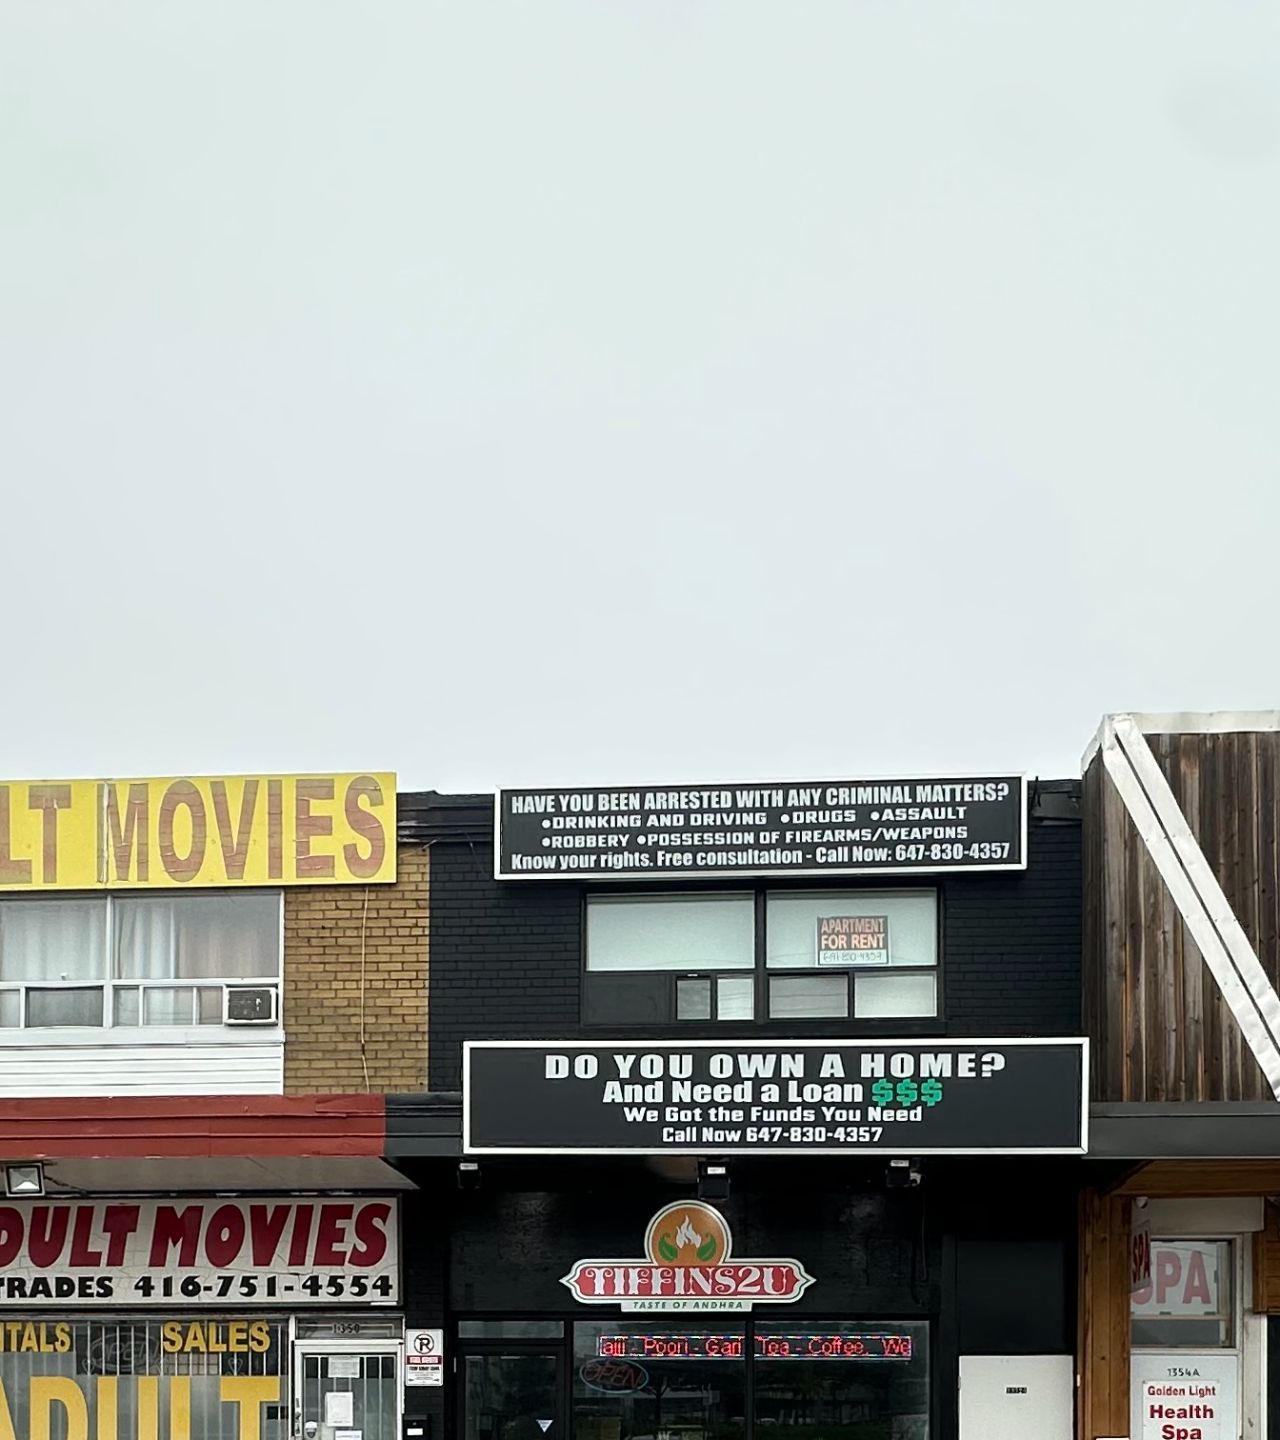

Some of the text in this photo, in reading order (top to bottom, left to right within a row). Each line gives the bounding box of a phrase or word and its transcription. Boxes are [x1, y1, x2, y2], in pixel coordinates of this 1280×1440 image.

[512, 783, 1009, 814] HAVE YOU BEEN ARRESTED WITH ANY CRIMINAL MATTERS?
[97, 775, 386, 883] MOVIES
[647, 813, 684, 828] AND
[690, 812, 767, 826] DRIVING
[759, 830, 780, 844] OF
[785, 826, 968, 843] FIREARMS/WEAPONS
[511, 854, 557, 870] Know
[559, 854, 597, 871] your
[600, 851, 654, 870] rights.
[657, 851, 693, 867] Free
[696, 848, 802, 867] consultation
[815, 846, 848, 863] Call
[852, 845, 892, 862] Now:
[895, 842, 1010, 861] 647-830-4357
[821, 918, 885, 933] APARTMENT
[821, 933, 885, 949] FOR RENT
[545, 1052, 1006, 1079] DO YOU OWN A HOME?
[602, 1078, 943, 1107] And Need a Loan $$$
[623, 1106, 922, 1122] We Got the Funds You Need
[662, 1126, 883, 1142] Call Now 647-830-4357
[149, 1203, 393, 1268] MOVIES
[134, 1274, 394, 1299] 416-751-4554
[585, 1266, 789, 1295] TIFFINS2U
[634, 1301, 743, 1309] TASTE OF ANDHRA
[163, 1320, 270, 1352] SALES
[333, 1323, 360, 1334] 1350
[584, 1359, 642, 1388] OPEN
[1167, 1368, 1200, 1376] 1354A
[1148, 1385, 1216, 1397] Golden Light
[1149, 1405, 1214, 1418] Health
